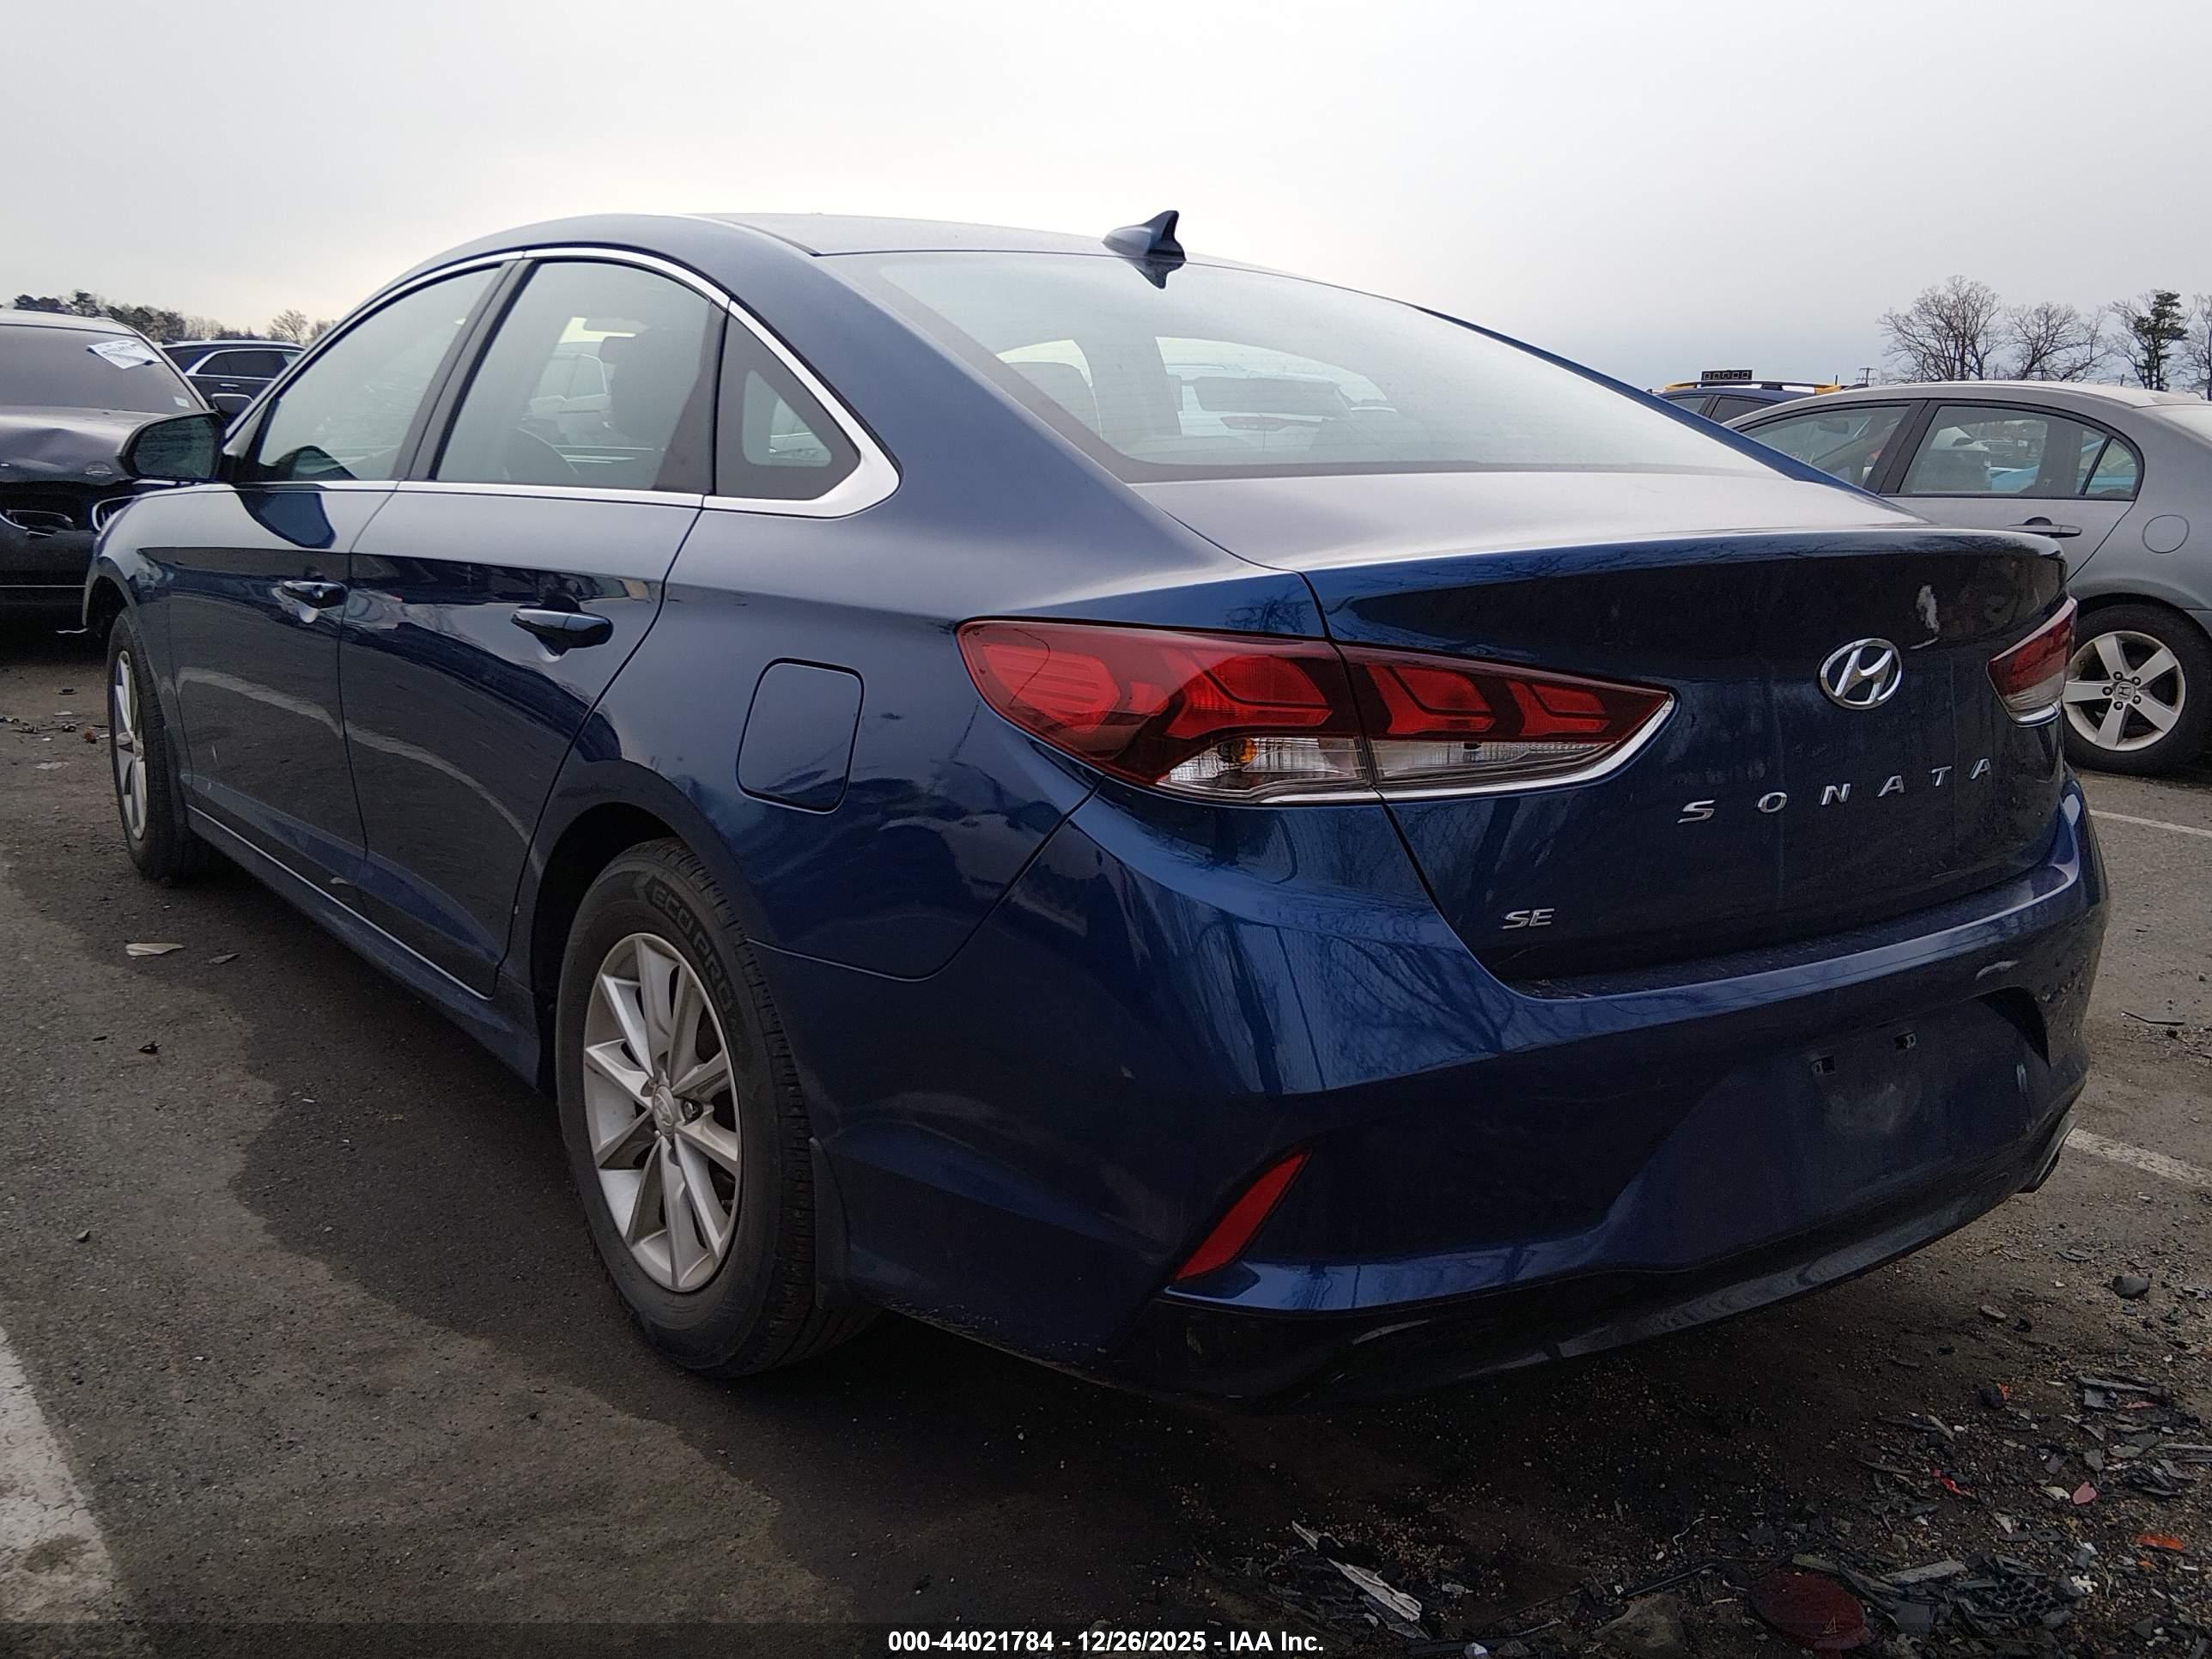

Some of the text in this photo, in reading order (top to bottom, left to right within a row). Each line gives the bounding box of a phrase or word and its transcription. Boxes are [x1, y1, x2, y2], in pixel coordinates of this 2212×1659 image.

[1677, 757, 1992, 823] SONATA
[651, 884, 732, 1013] ECO PRO
[1501, 908, 1555, 930] SE
